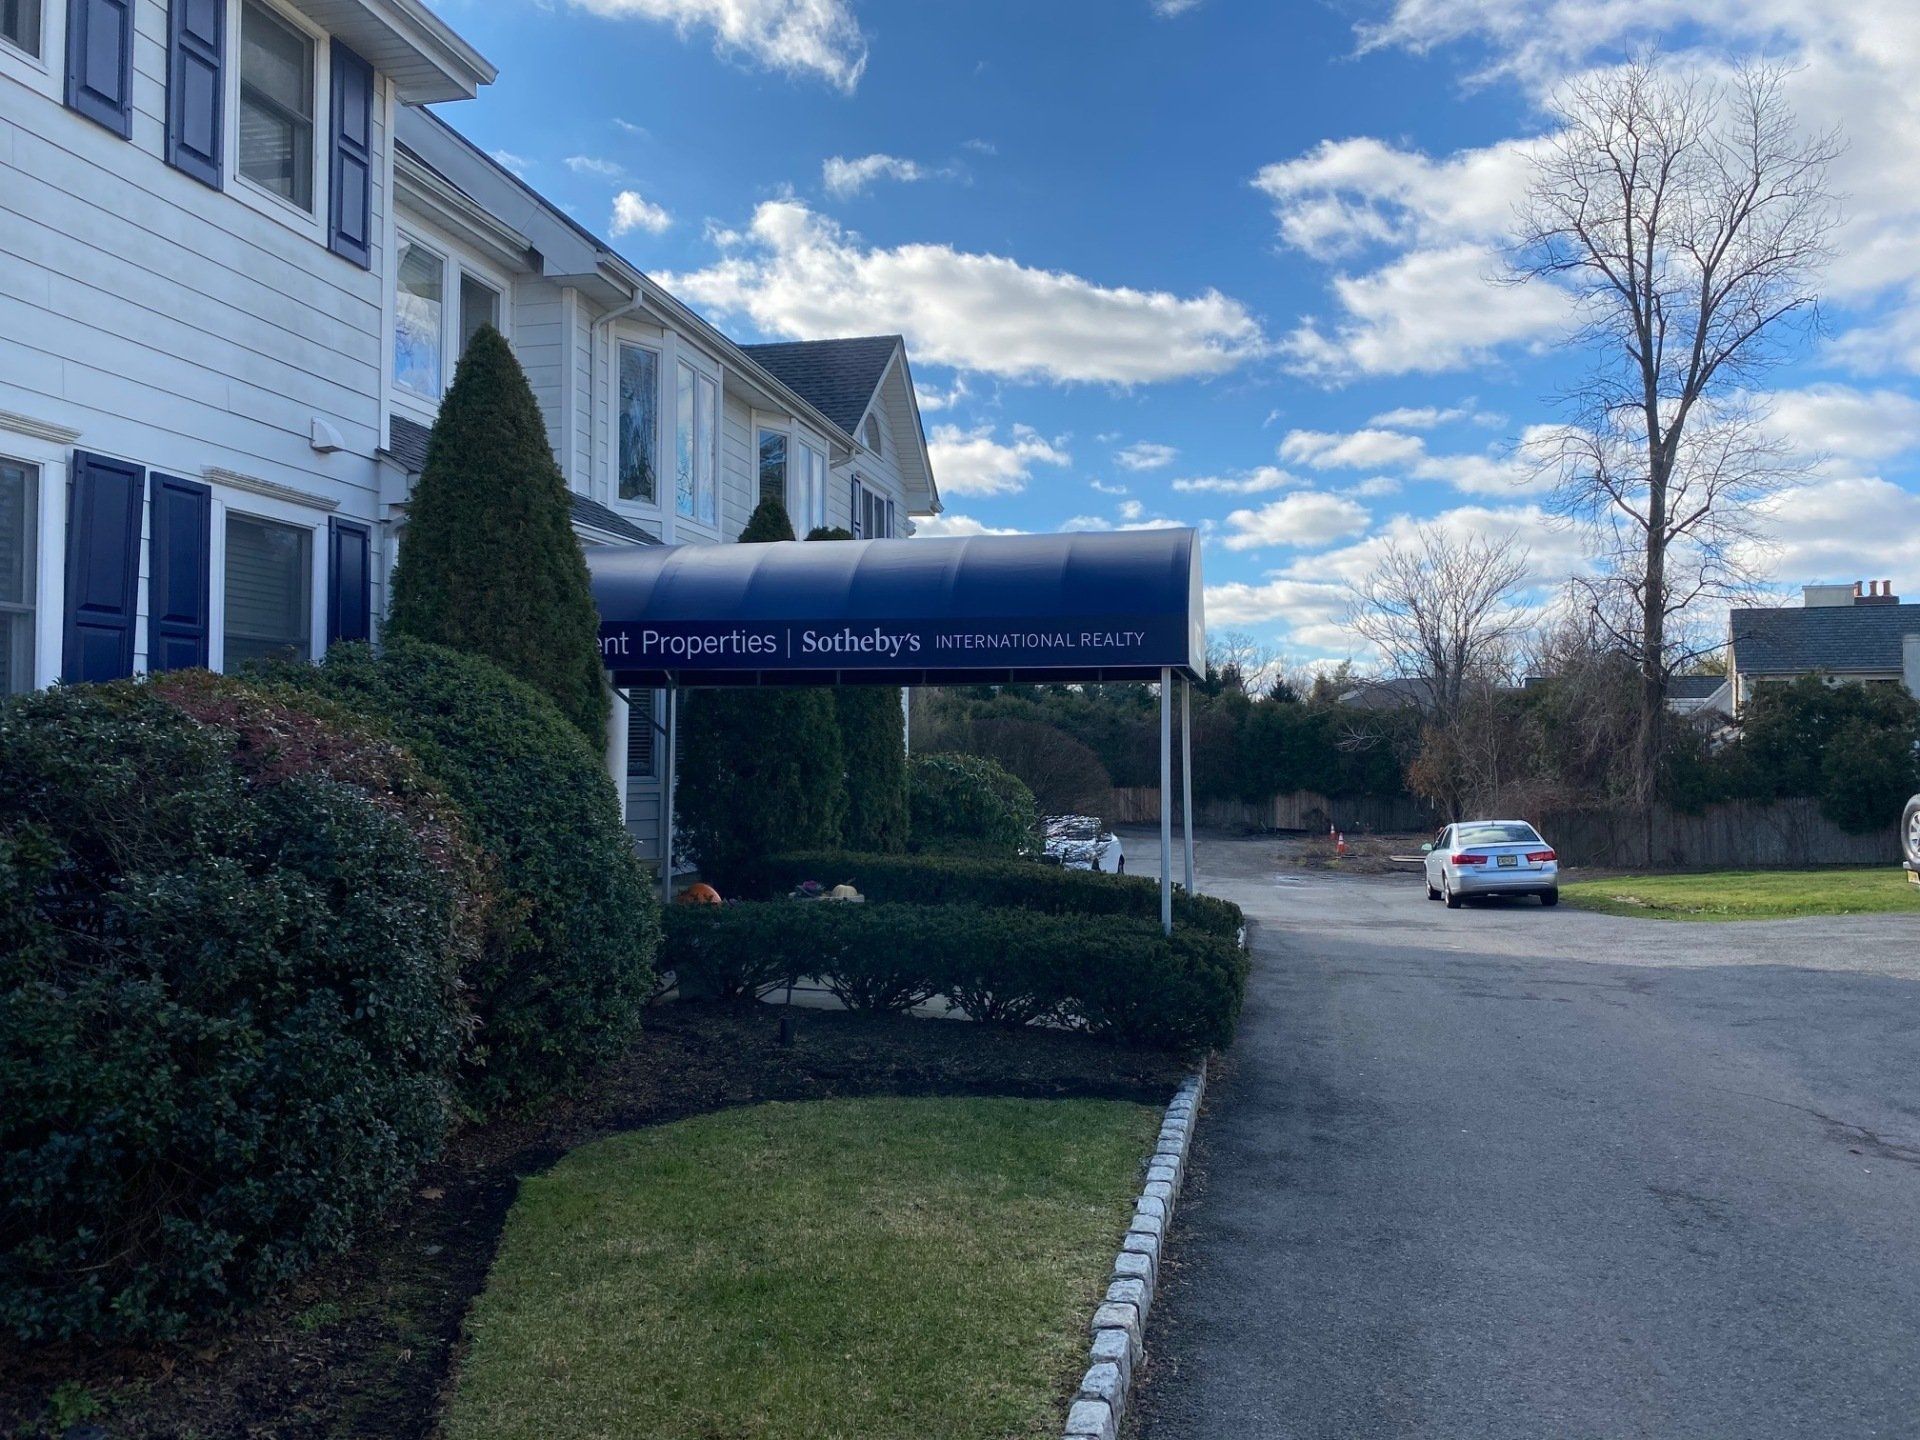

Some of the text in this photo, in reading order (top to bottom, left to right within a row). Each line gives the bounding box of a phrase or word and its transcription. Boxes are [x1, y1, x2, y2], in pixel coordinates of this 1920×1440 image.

[643, 630, 777, 660] Properties
[802, 627, 921, 658] Sotheby's
[935, 632, 1076, 649] INTERNATIONAL
[1080, 631, 1146, 647] REALTY
